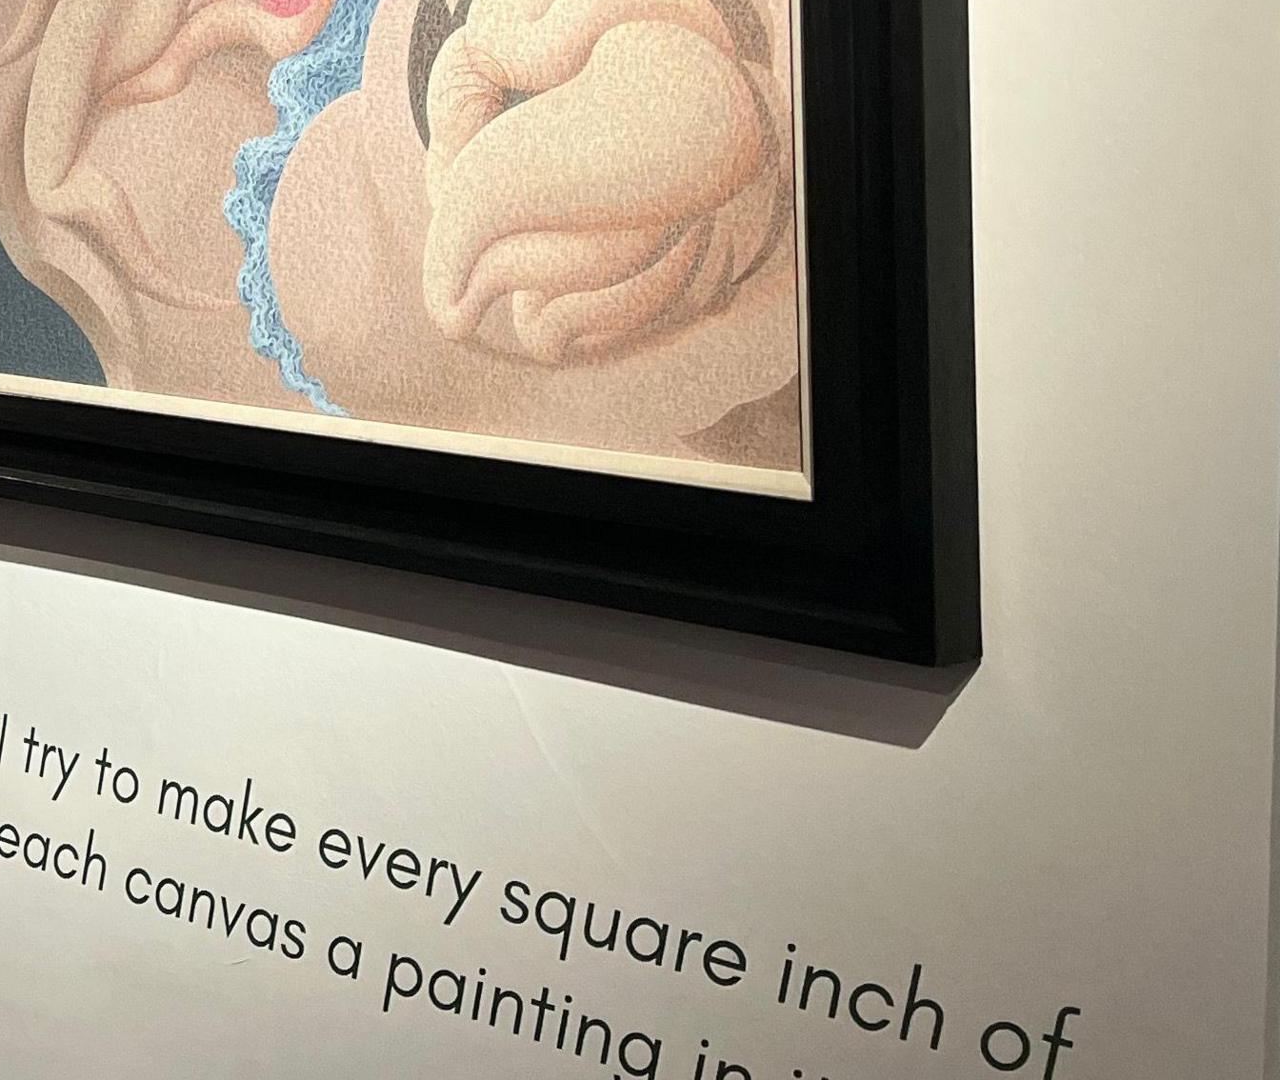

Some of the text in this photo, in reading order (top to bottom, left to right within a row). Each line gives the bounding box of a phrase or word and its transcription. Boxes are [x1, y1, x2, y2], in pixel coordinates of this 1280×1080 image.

[23, 726, 80, 801] try
[95, 747, 139, 804] to
[158, 779, 297, 852] make
[319, 828, 482, 926] every
[500, 880, 747, 987] square
[777, 943, 945, 1051] inch
[980, 1006, 1082, 1080] of
[125, 868, 306, 959] canvas
[327, 930, 363, 980] a
[382, 953, 662, 1080] painting
